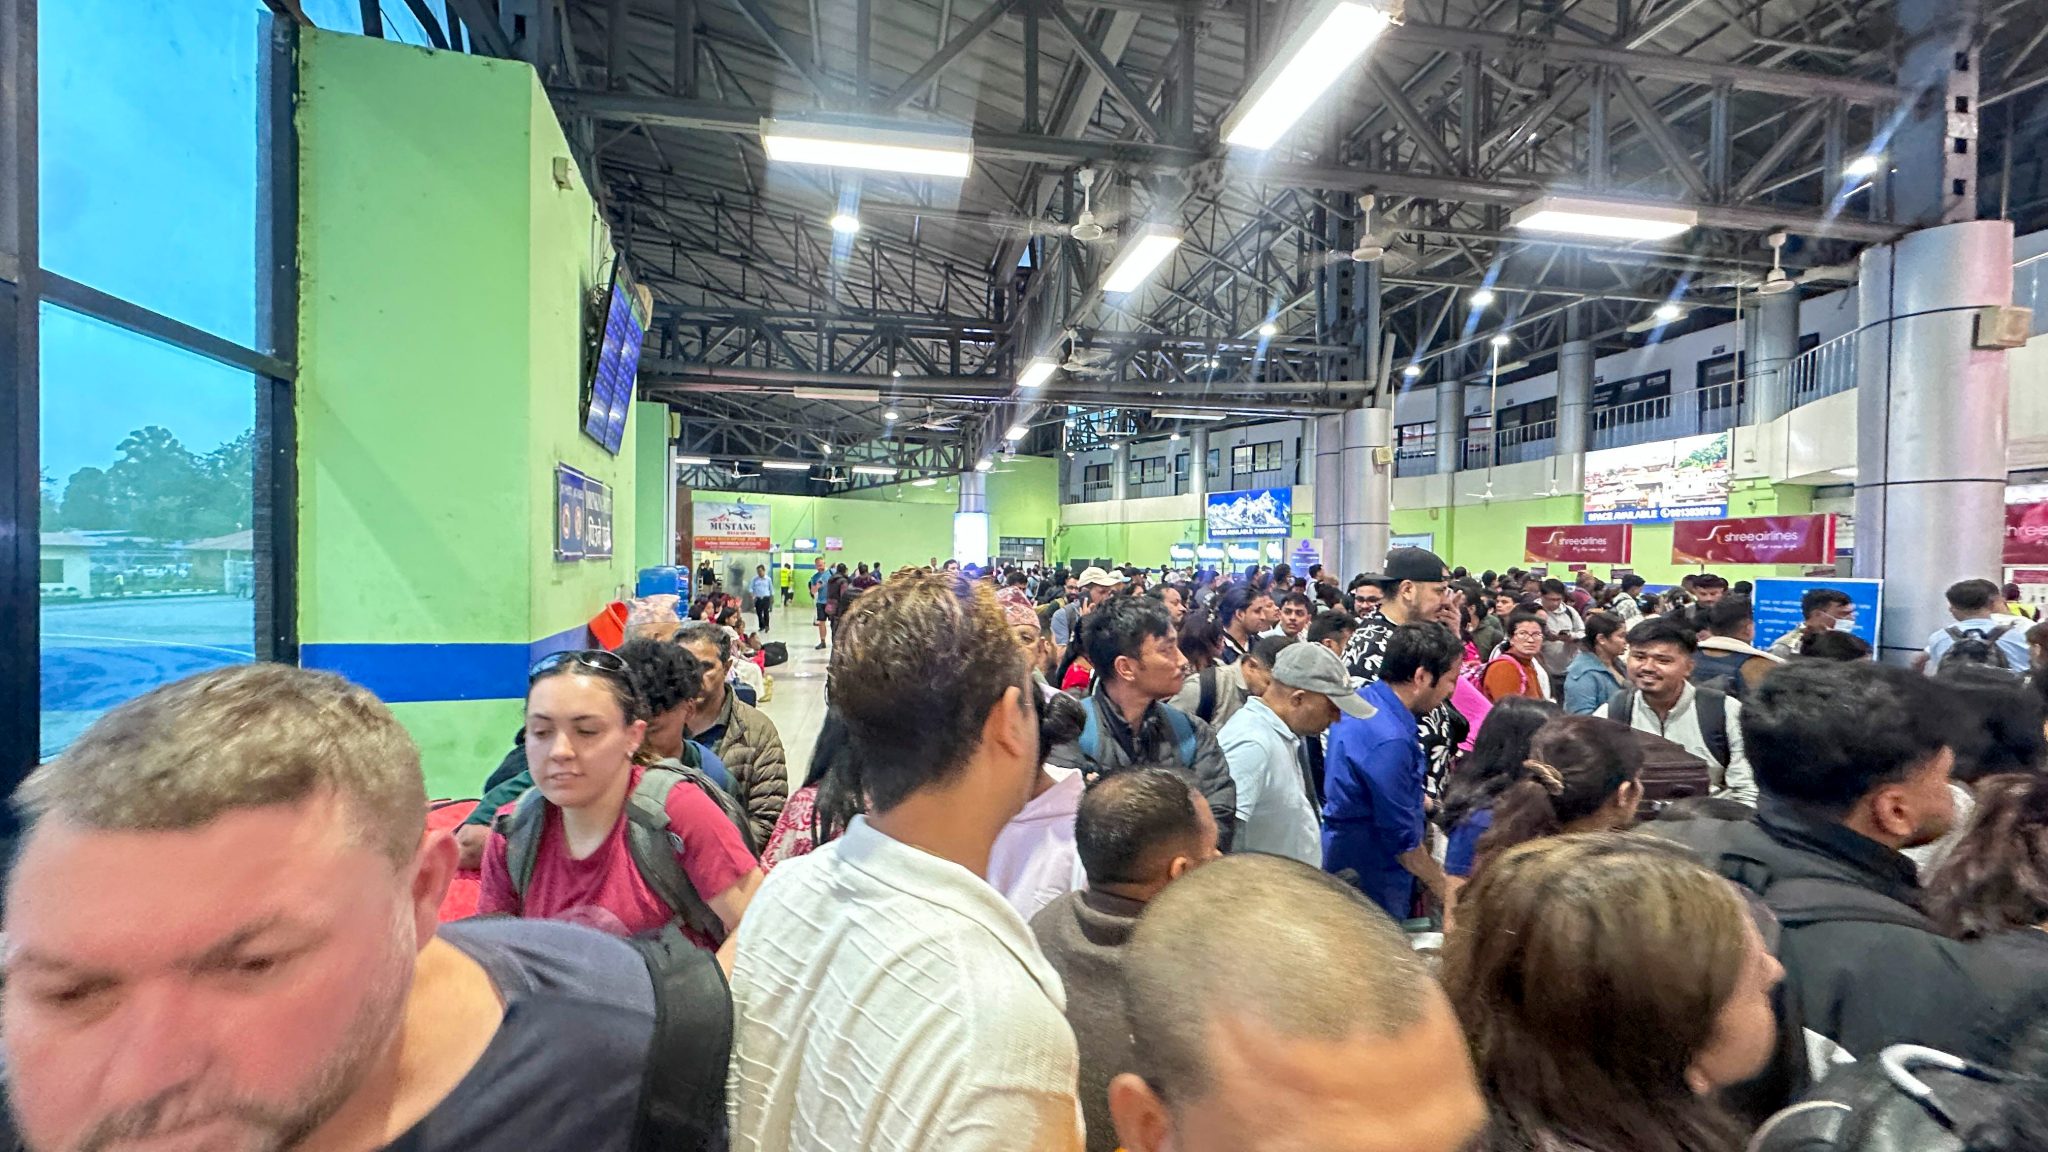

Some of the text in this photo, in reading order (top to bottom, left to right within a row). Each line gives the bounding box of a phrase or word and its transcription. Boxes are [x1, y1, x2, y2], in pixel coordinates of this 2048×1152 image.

[1614, 509, 1657, 520] AVAILABLE
[710, 522, 756, 531] MUSTANG
[2004, 525, 2048, 537] hree
